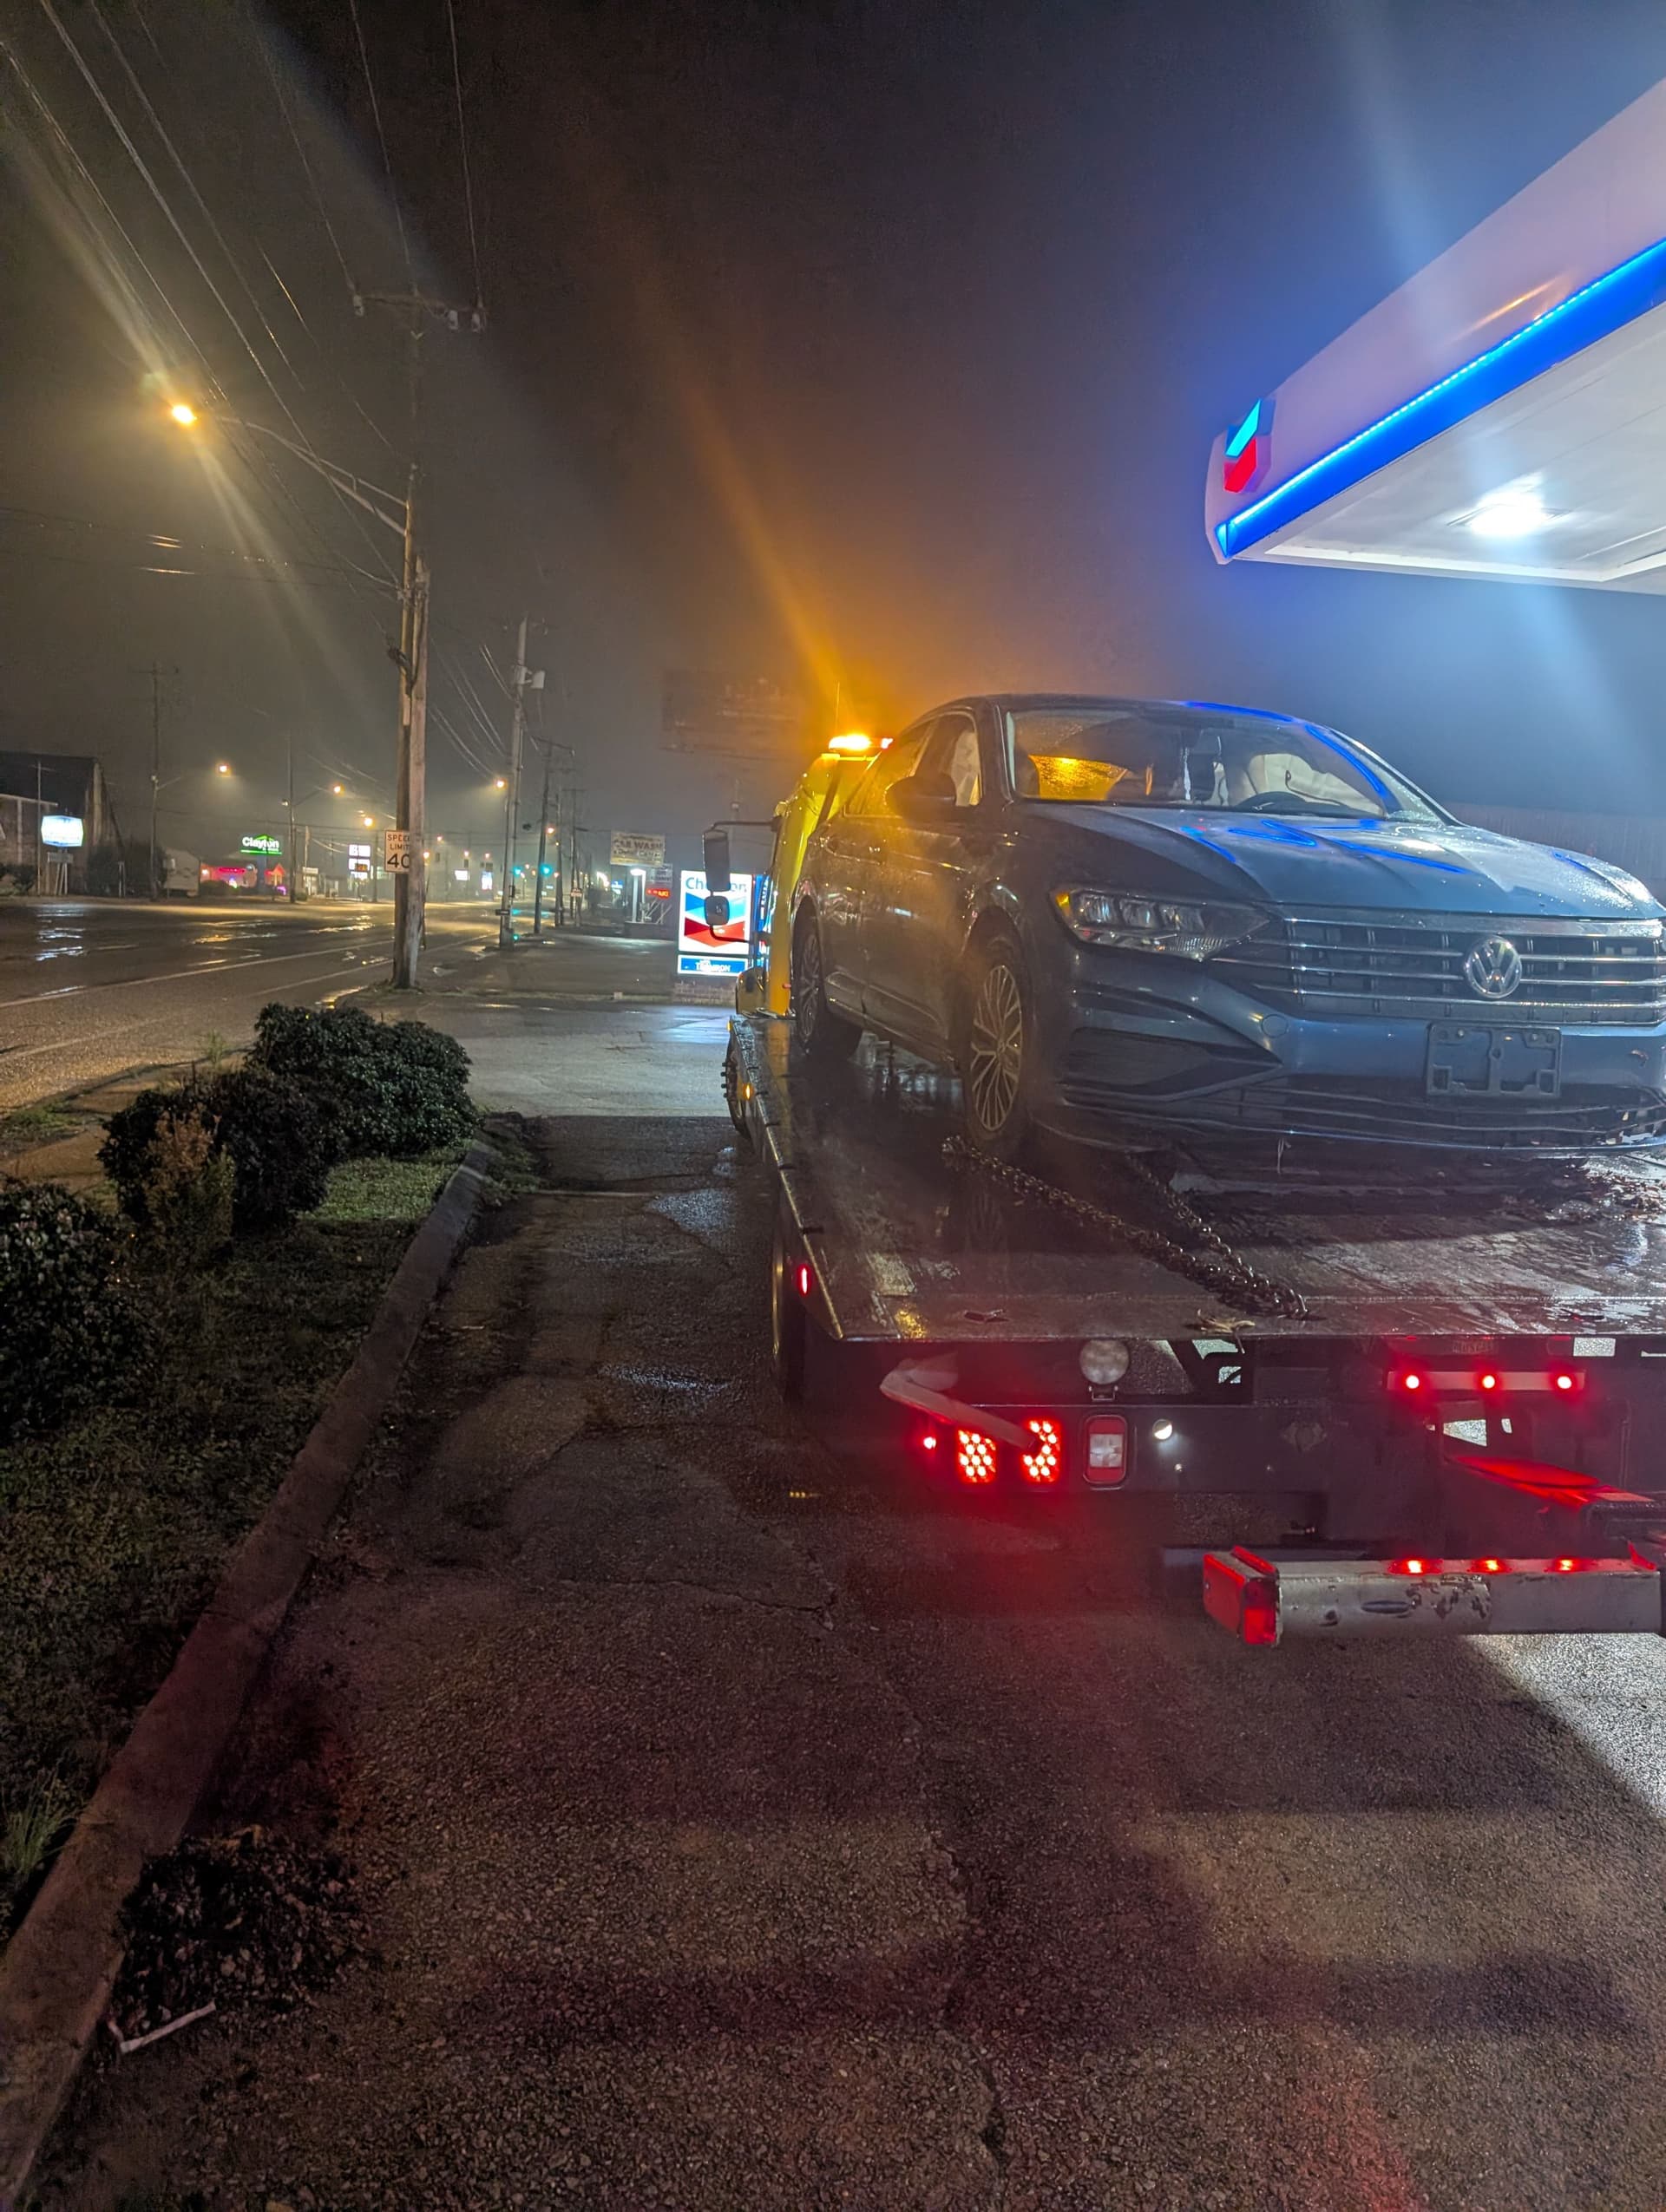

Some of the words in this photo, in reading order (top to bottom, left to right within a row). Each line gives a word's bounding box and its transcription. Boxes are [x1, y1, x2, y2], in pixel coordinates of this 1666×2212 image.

[242, 836, 279, 849] Clayton
[387, 853, 410, 869] 40
[685, 876, 747, 893] Chon
